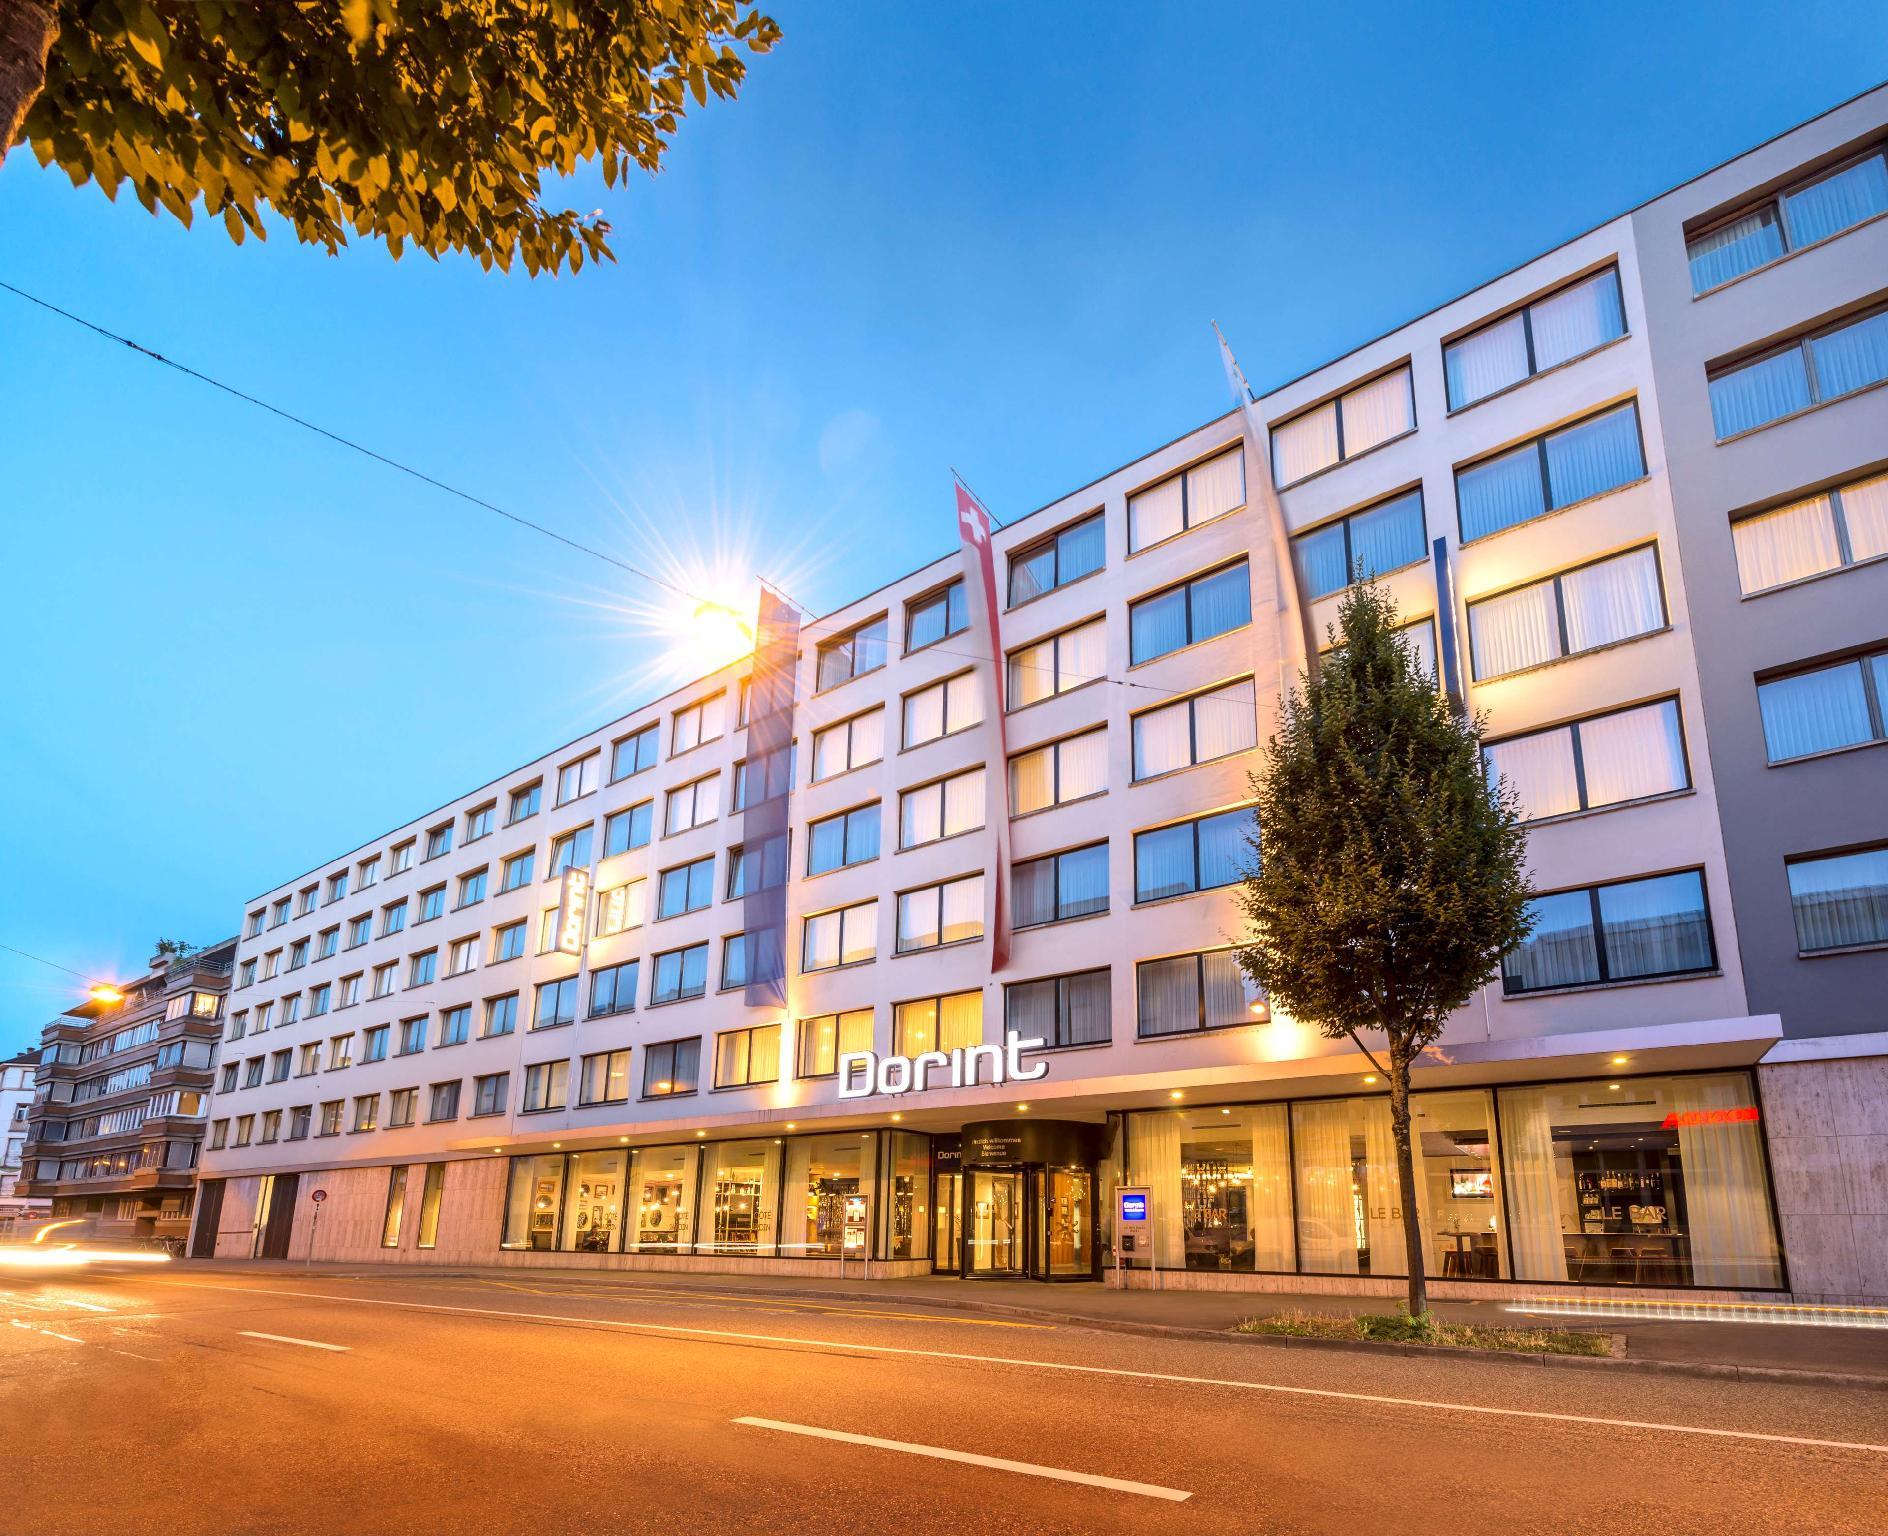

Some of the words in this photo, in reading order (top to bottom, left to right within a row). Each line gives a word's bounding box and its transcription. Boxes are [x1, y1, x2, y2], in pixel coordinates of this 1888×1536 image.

[839, 1030, 1049, 1099] Dorint
[937, 1151, 961, 1160] Dorin
[1204, 1208, 1227, 1220] BAR
[1370, 1207, 1386, 1220] LE
[1601, 1206, 1622, 1220] LE
[1628, 1205, 1668, 1220] BAR
